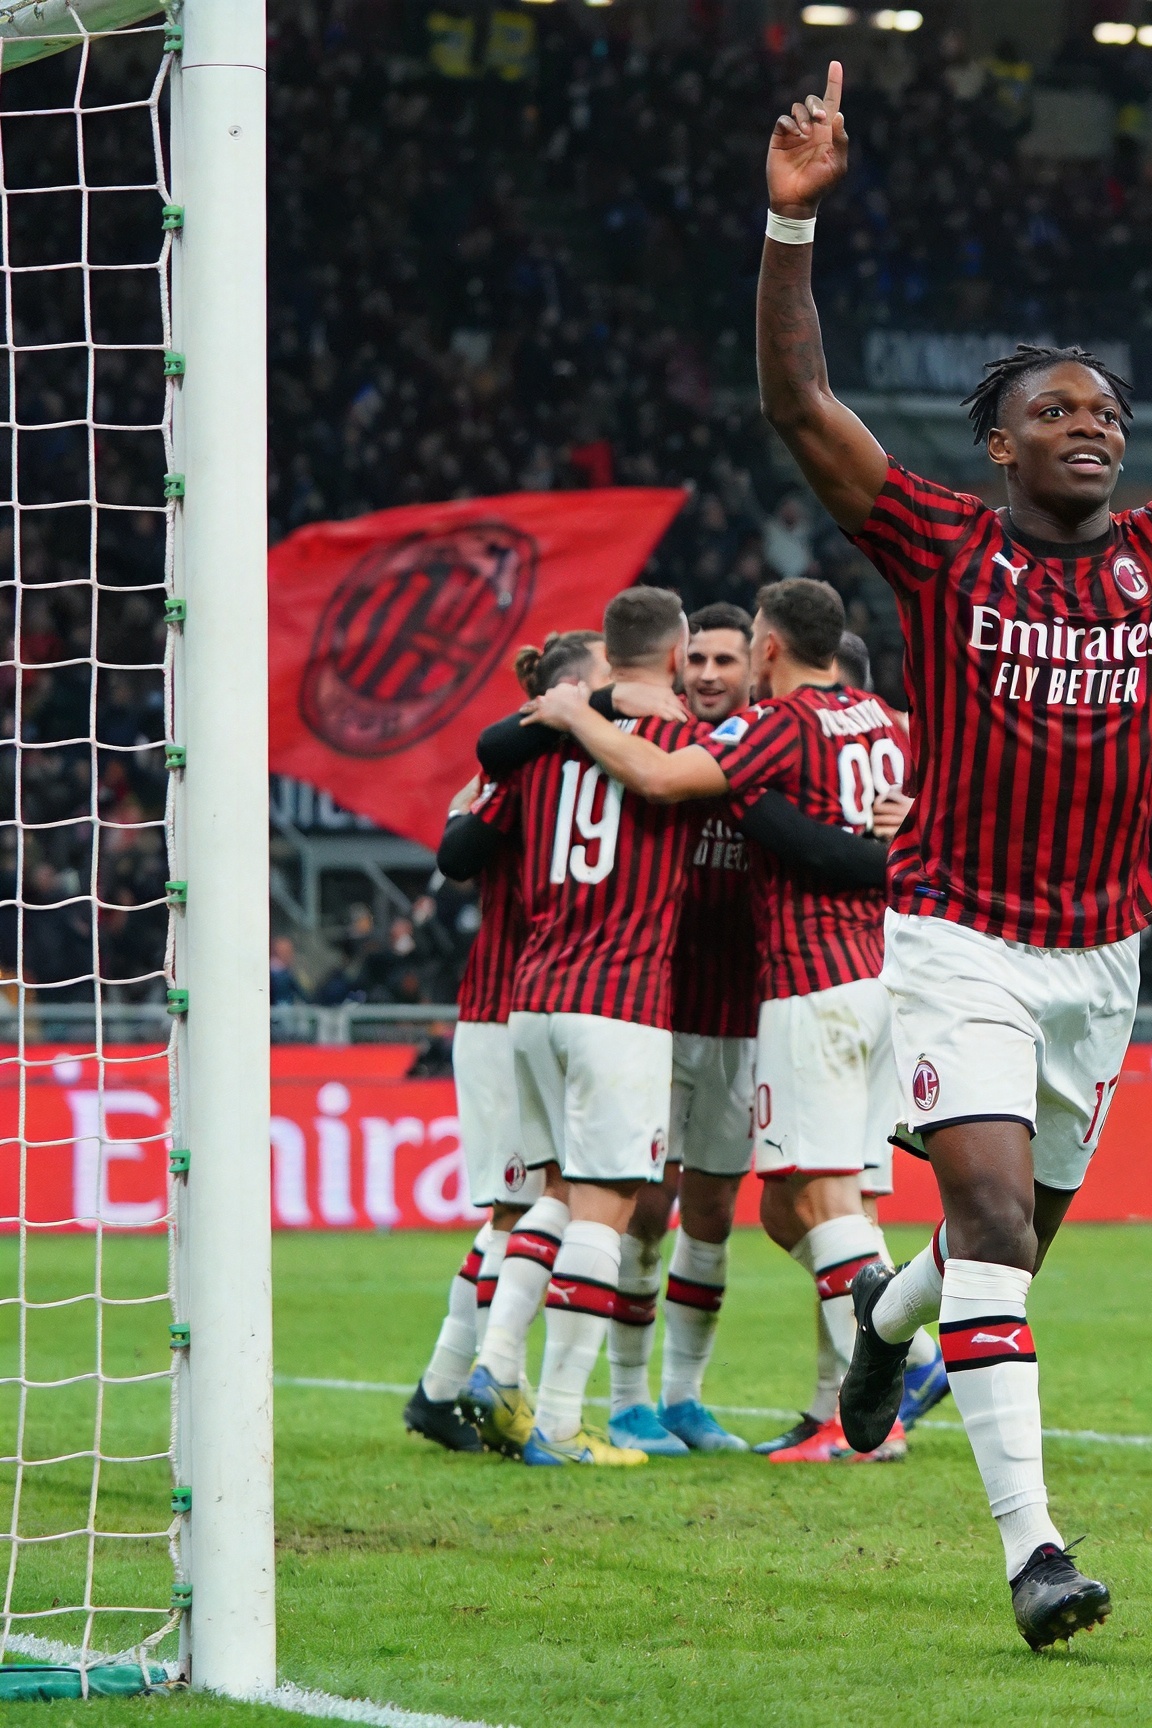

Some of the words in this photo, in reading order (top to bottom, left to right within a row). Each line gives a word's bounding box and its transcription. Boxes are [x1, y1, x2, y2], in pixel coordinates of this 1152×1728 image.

[993, 662, 1040, 702] FLY
[1046, 666, 1140, 705] BETTER
[550, 759, 625, 885] 19
